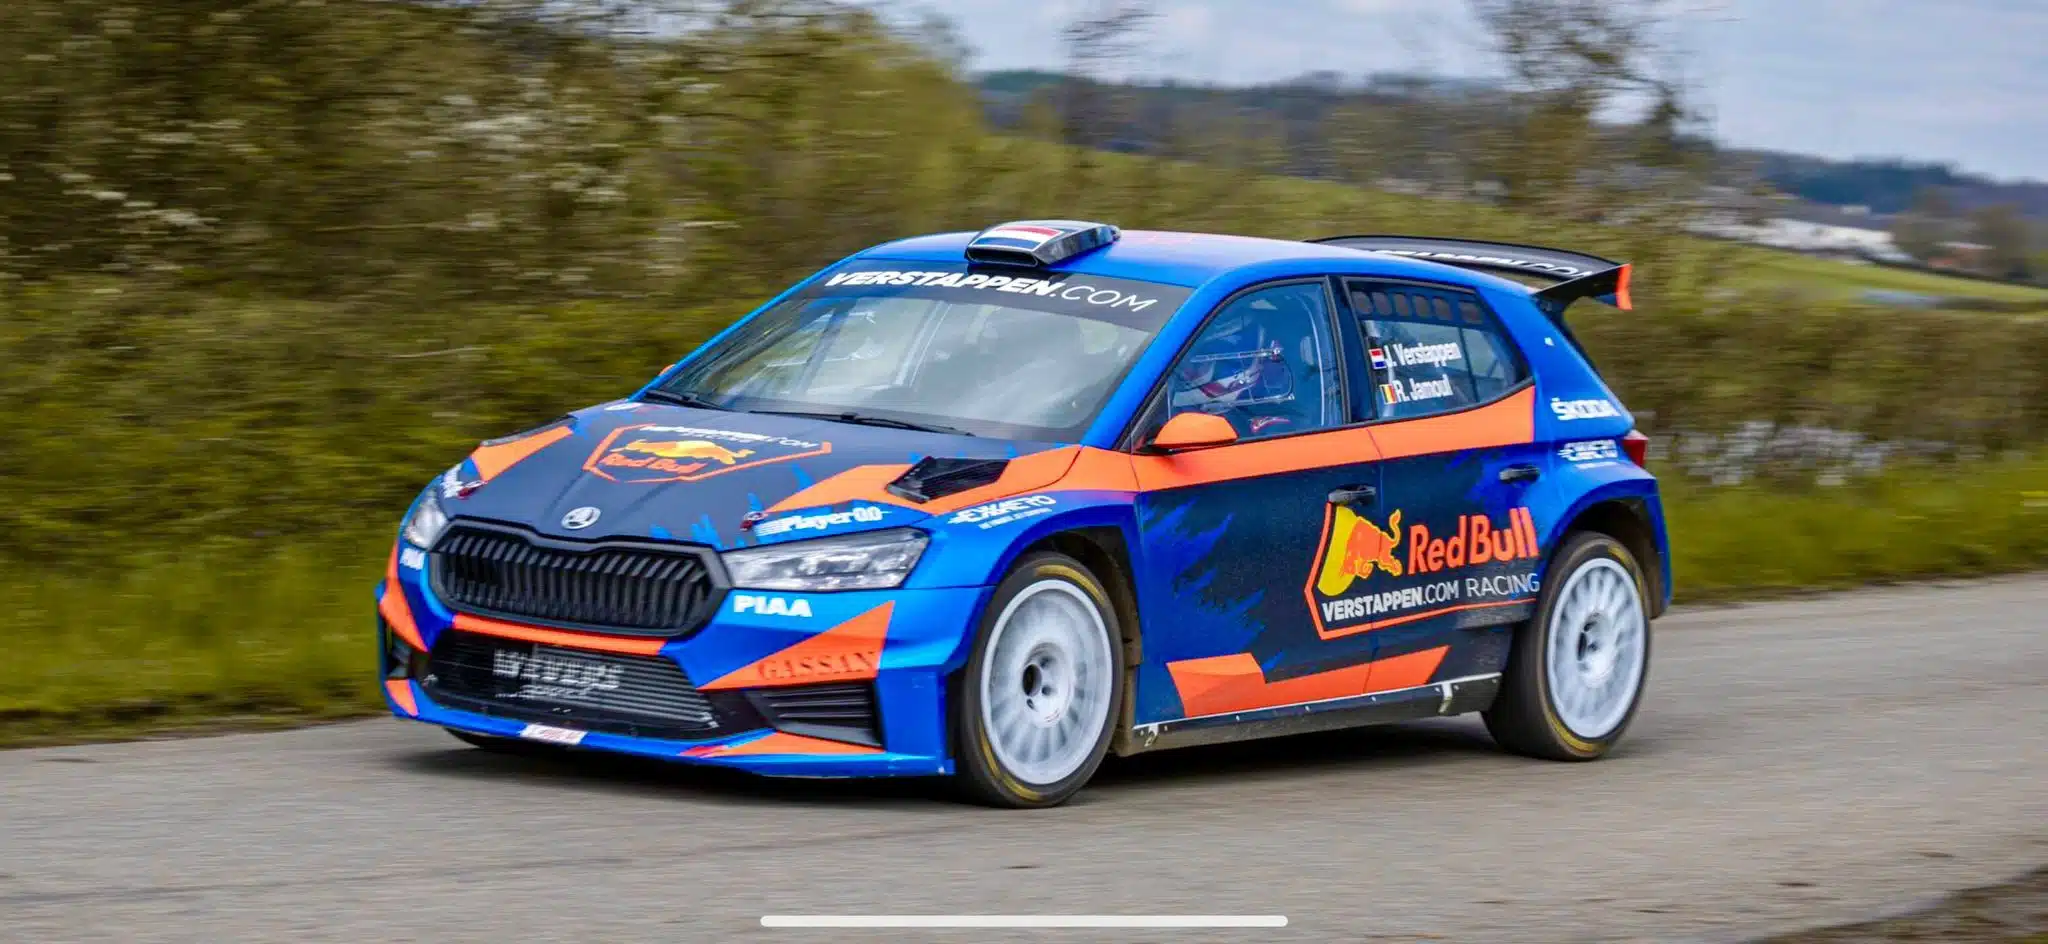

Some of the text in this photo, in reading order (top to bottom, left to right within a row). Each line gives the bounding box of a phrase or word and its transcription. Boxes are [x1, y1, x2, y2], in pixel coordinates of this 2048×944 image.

[824, 271, 1157, 313] VERSTAPPEN.COM
[1392, 342, 1462, 367] Verstappen
[1392, 380, 1411, 402] R.
[733, 596, 813, 618] PIAA
[1322, 573, 1541, 622] VERSTAPPEN.COM RACING
